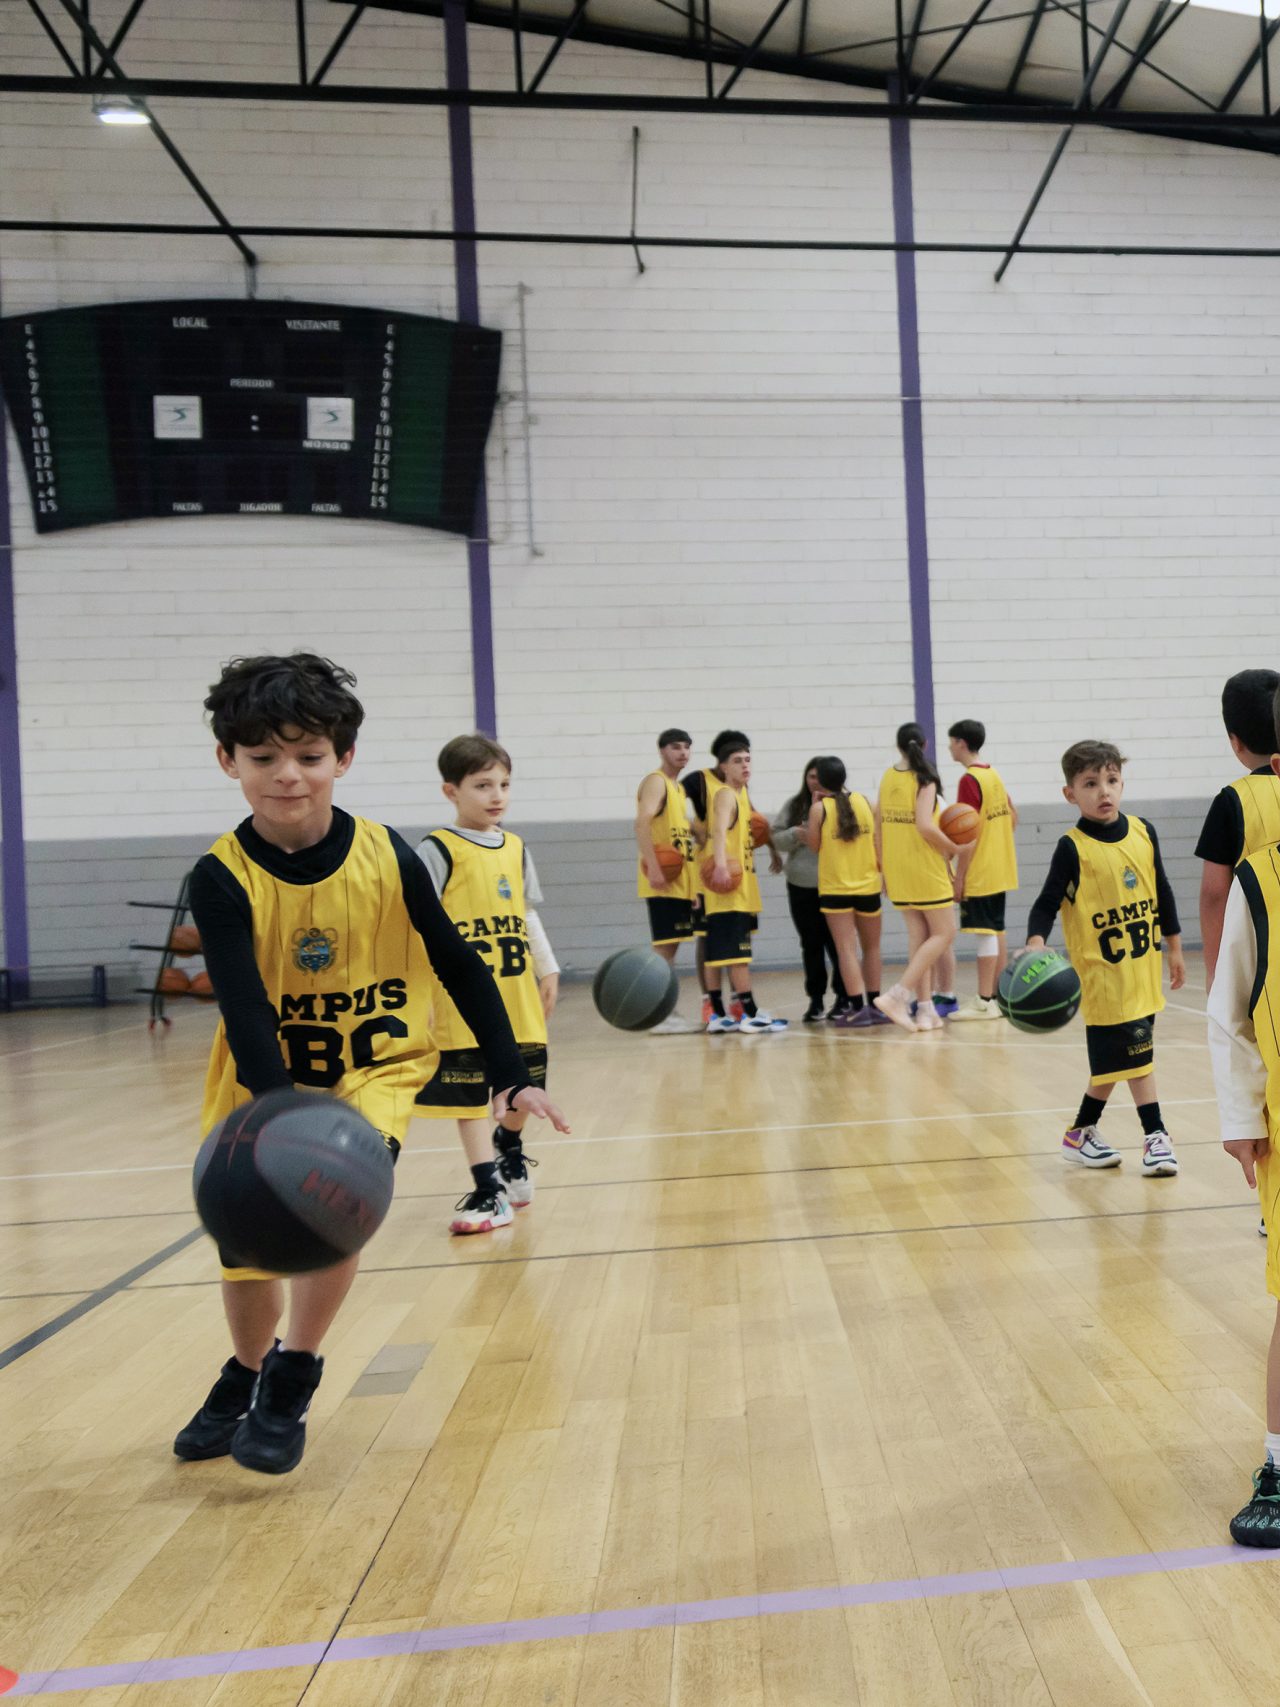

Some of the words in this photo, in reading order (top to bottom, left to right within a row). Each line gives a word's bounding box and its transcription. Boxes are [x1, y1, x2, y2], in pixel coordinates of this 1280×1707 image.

[172, 317, 209, 329] LOCAL
[286, 319, 341, 331] VISITANTE
[25, 339, 35, 350] 4
[384, 339, 394, 351] 4
[26, 351, 38, 365] 5
[383, 352, 394, 366] 5
[28, 367, 39, 380] 6
[382, 367, 392, 380] 6
[30, 381, 40, 394] 7
[381, 381, 392, 394] 7
[32, 396, 42, 409] 8
[380, 395, 391, 408] 8
[33, 411, 44, 424] 9
[380, 410, 390, 422] 9
[31, 426, 49, 439] 10
[375, 423, 392, 437] 10
[33, 440, 50, 454] 11
[374, 438, 391, 451] 11
[35, 455, 53, 468] 12
[373, 452, 391, 466] 12
[36, 470, 54, 484] 13
[372, 467, 390, 480] 13
[370, 480, 389, 494] 14
[39, 500, 58, 513] 15
[172, 502, 204, 512] FALTAS
[311, 503, 342, 513] FALTAS
[369, 495, 388, 509] 15
[280, 977, 408, 1023] MPUS
[280, 1014, 409, 1089] BC
